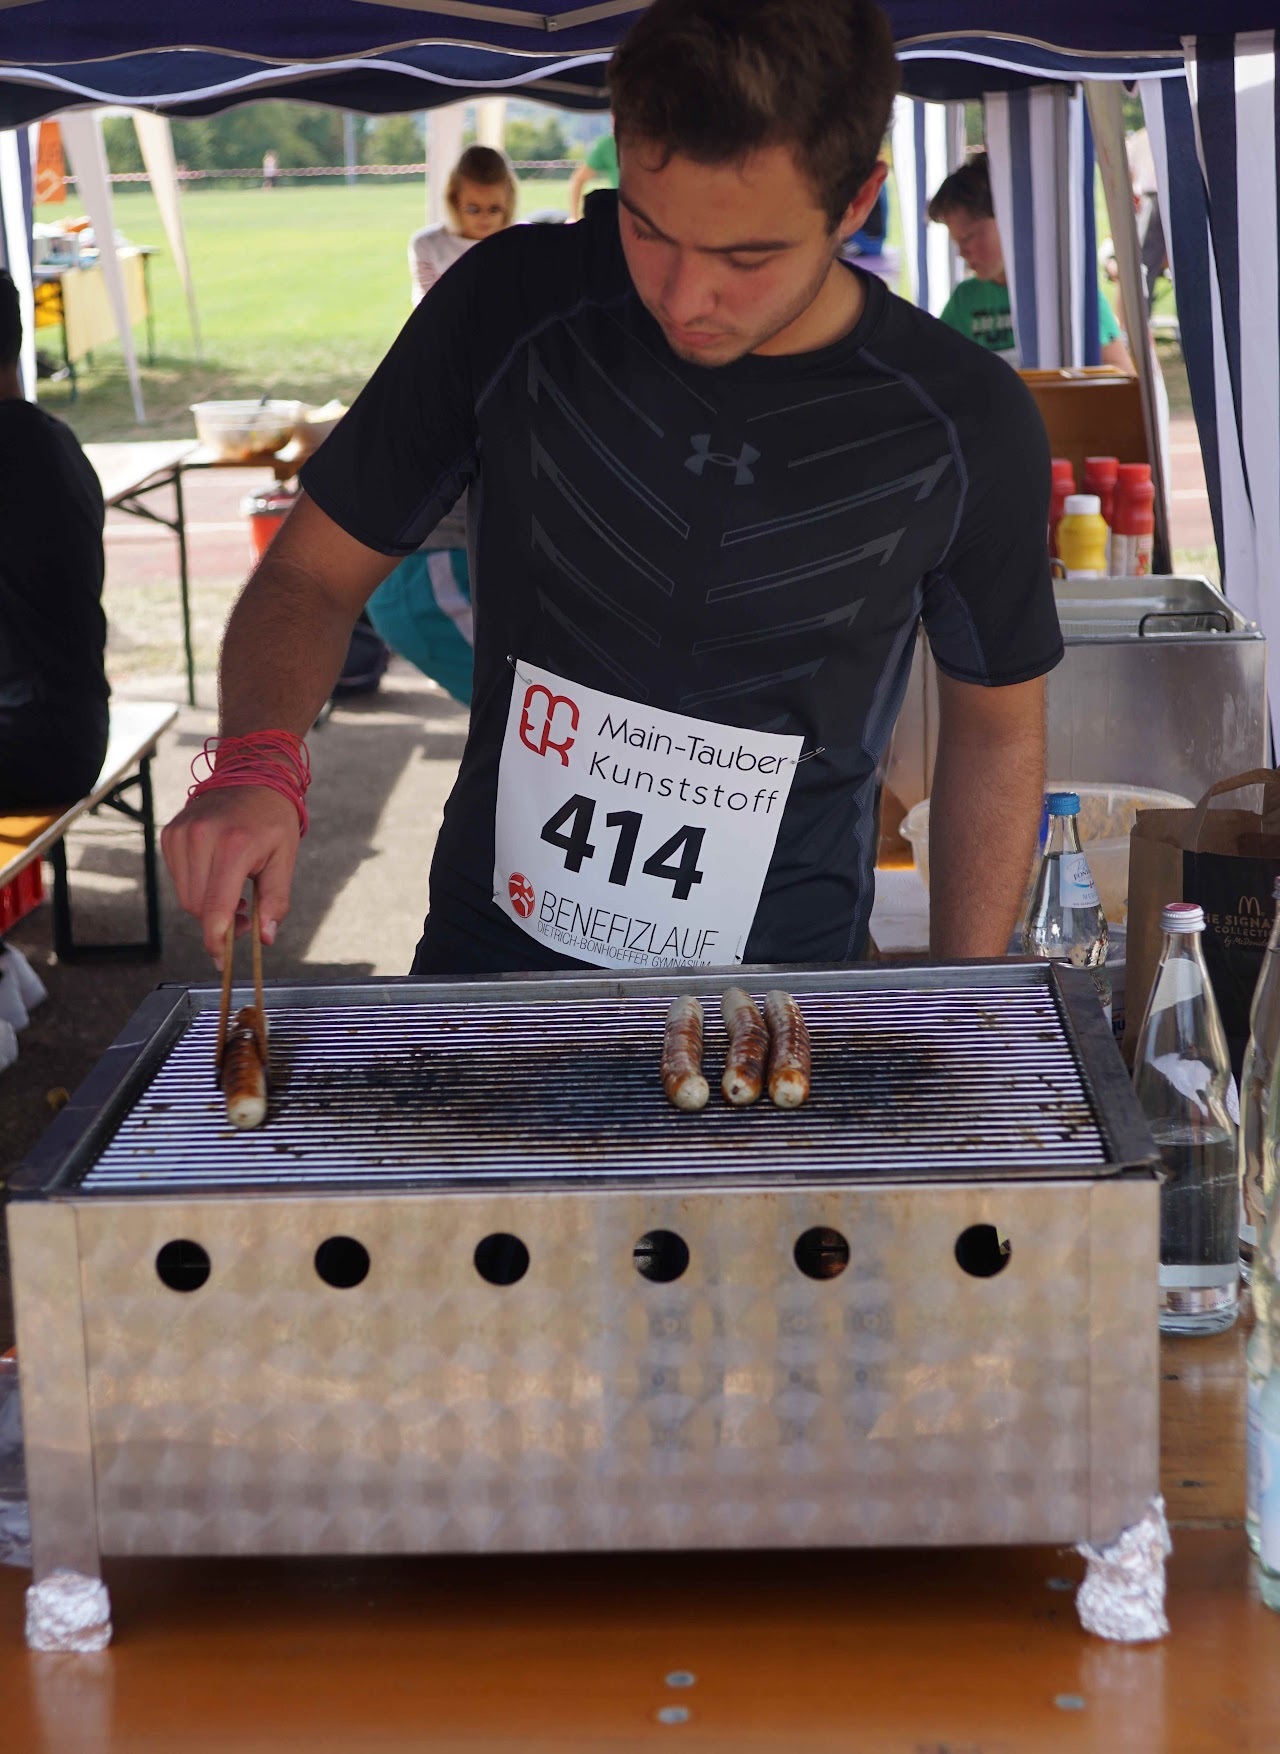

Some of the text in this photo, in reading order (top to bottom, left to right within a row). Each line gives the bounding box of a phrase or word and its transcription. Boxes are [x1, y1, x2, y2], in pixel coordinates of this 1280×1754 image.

[598, 714, 789, 775] Main-Tauber
[589, 752, 779, 814] Kunststoff
[540, 793, 706, 900] 414
[537, 920, 649, 966] DIETRICH-BONHOEFFER
[539, 890, 719, 959] BENEFIZLAUF
[1224, 914, 1275, 929] SIGNA
